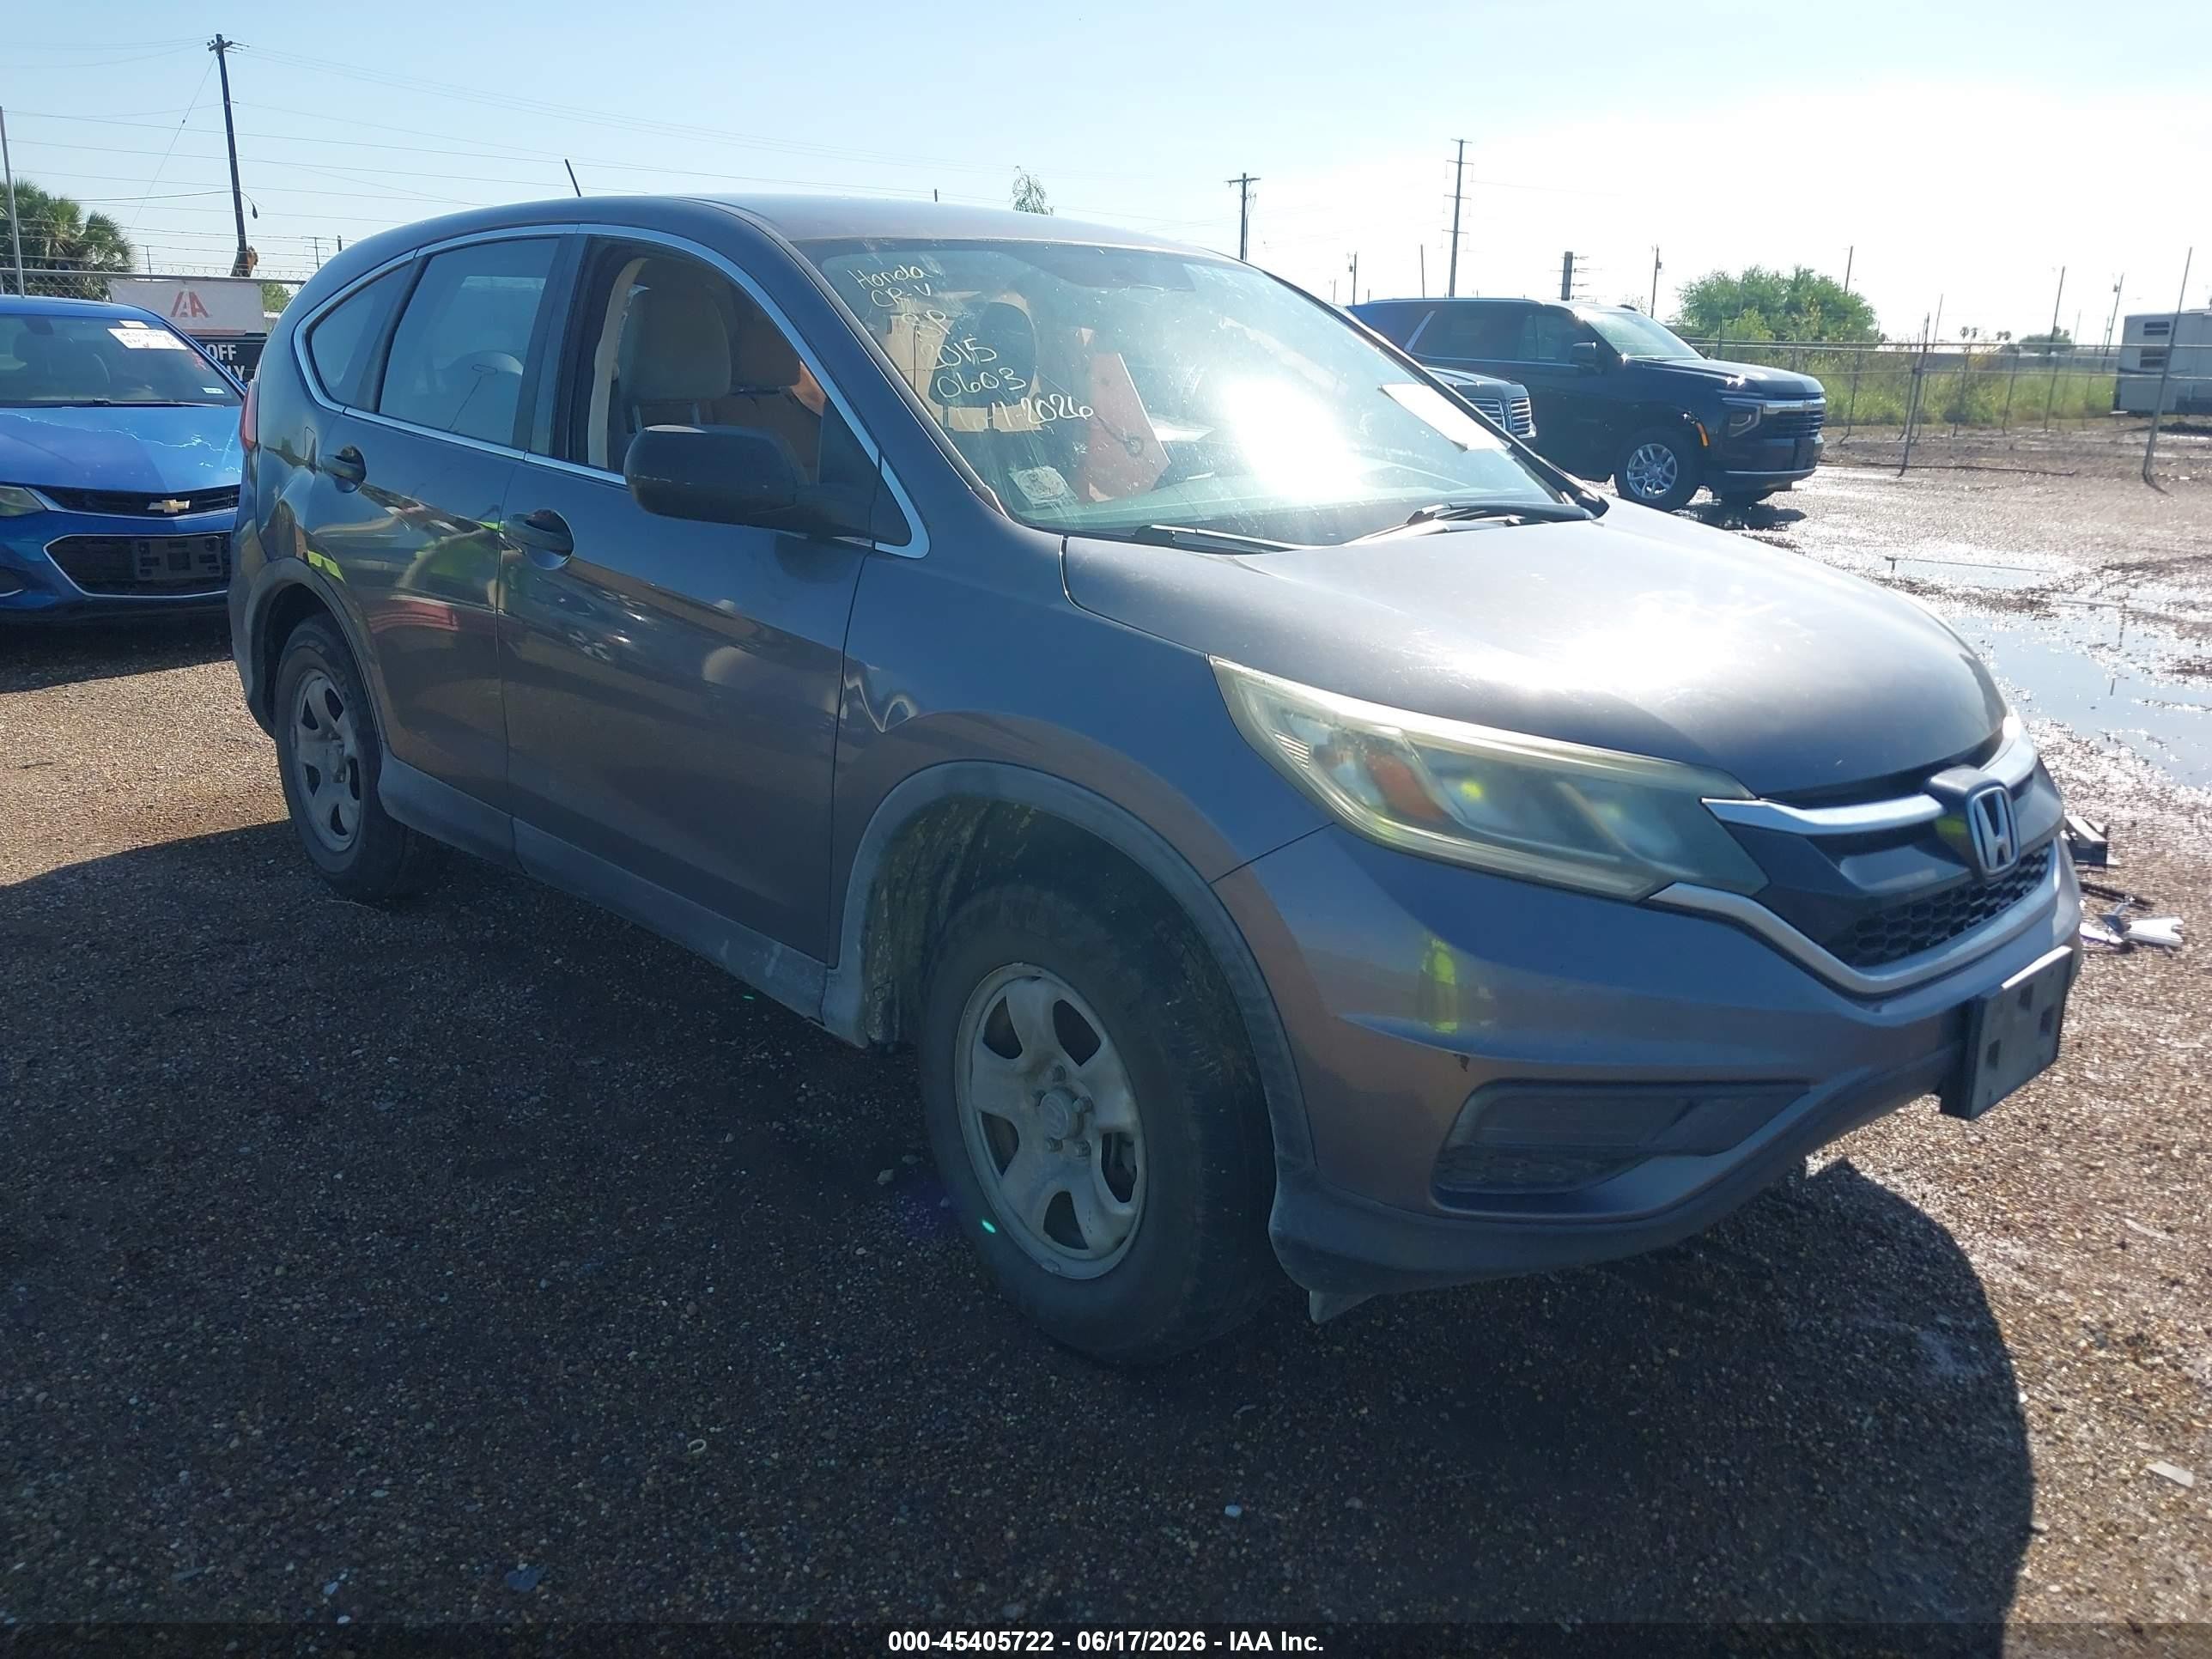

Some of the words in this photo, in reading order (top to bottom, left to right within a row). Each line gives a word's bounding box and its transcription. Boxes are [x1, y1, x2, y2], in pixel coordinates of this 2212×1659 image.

[846, 264, 934, 290] Honda
[871, 283, 932, 307] CR-V
[205, 343, 237, 362] OFF
[919, 337, 998, 370] 2015
[936, 367, 1027, 398] 0603
